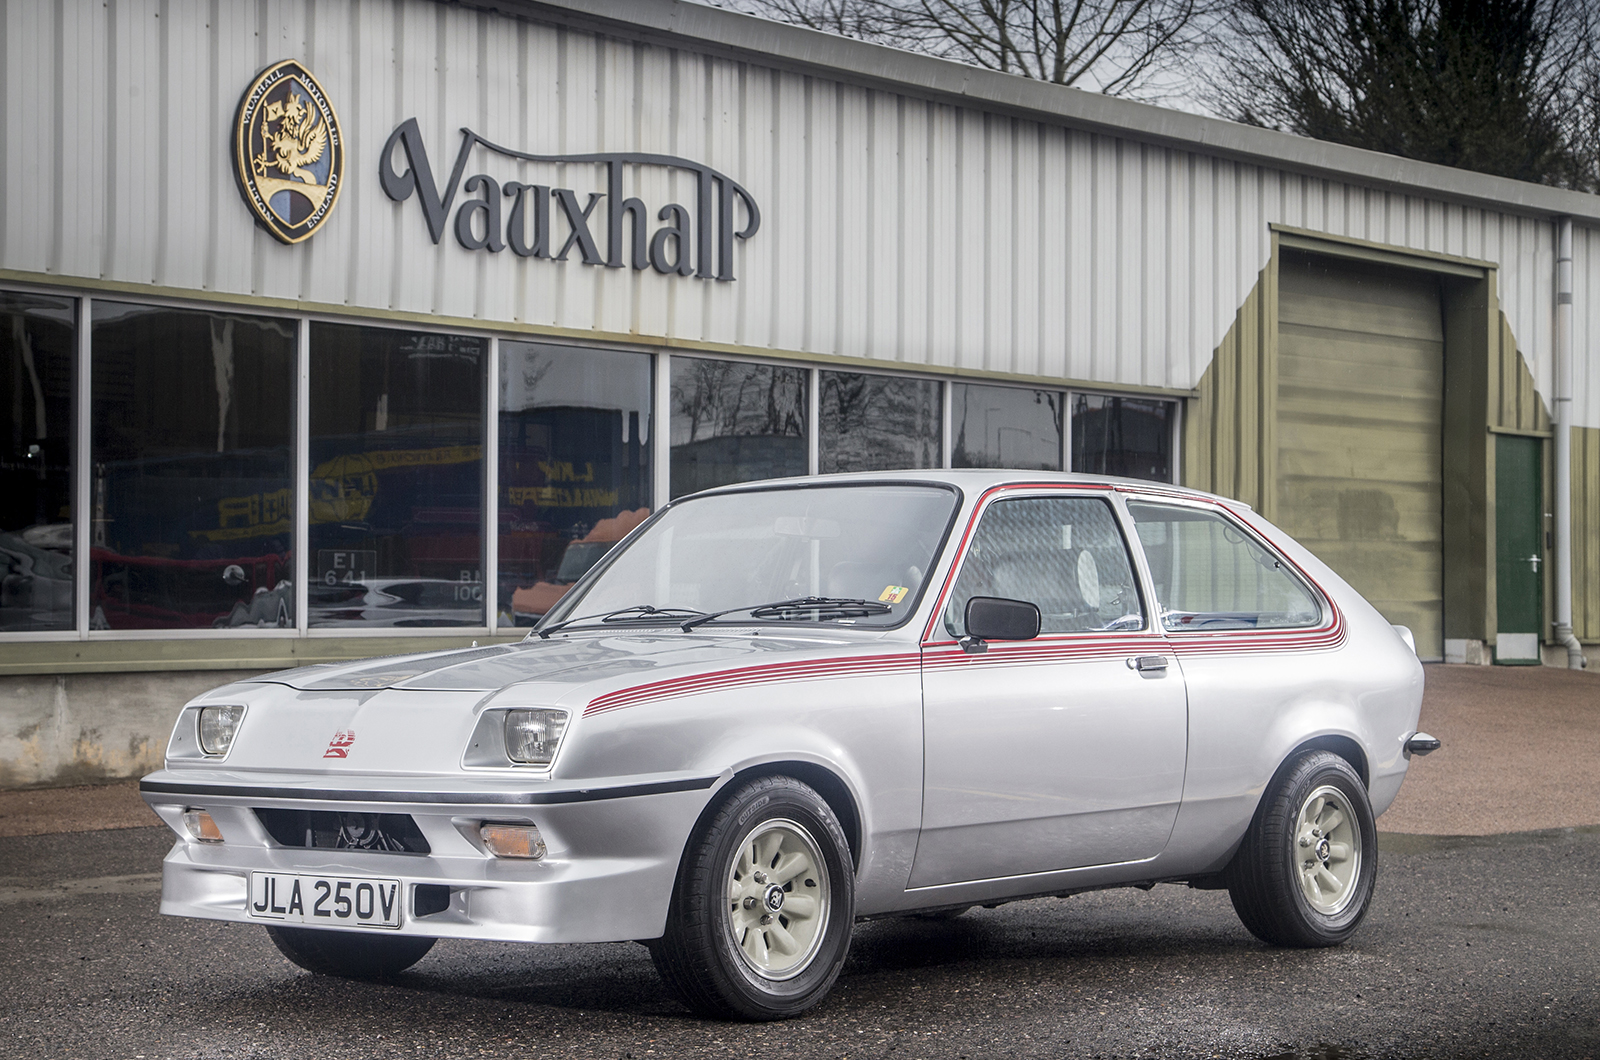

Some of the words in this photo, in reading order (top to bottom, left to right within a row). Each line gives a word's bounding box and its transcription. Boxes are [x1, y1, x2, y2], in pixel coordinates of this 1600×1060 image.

[243, 69, 284, 124] VAUXHALL
[300, 73, 333, 123] MOTORS
[306, 173, 338, 229] ENGLAND
[379, 117, 761, 281] Vauxhall
[325, 570, 366, 586] 641
[253, 877, 304, 915] JLA
[313, 880, 396, 921] 250V
